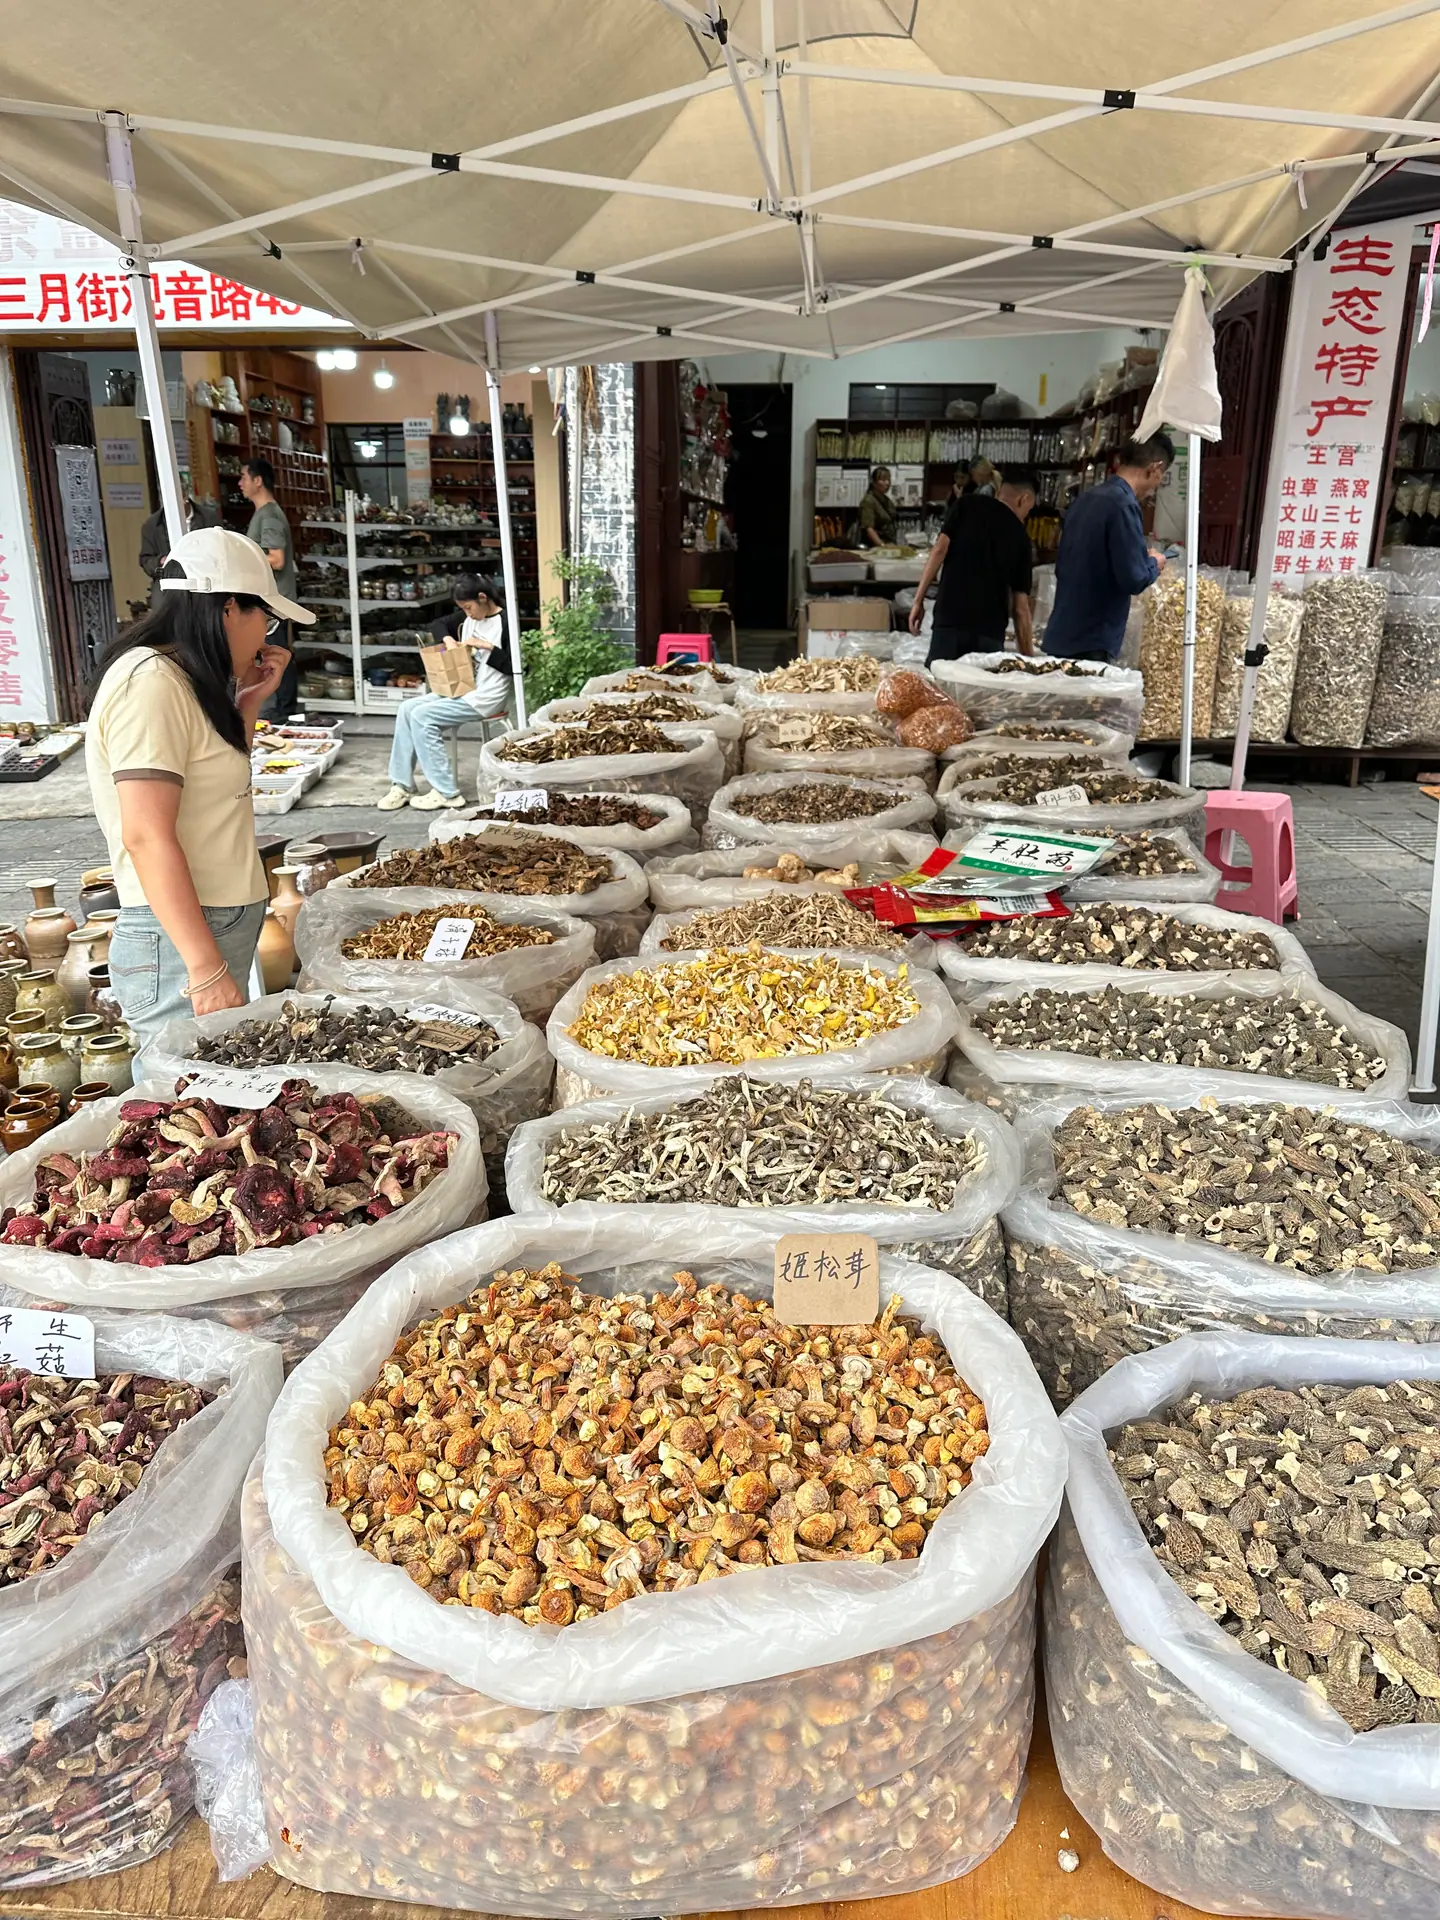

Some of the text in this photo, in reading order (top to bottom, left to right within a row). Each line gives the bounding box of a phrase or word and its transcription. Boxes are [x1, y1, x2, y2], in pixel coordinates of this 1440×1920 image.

[1306, 235, 1395, 437] 生态特产
[1281, 477, 1370, 499] 虫草 燕窝
[1279, 503, 1363, 524] 文山三七
[1276, 530, 1360, 550] 昭通天麻
[1273, 555, 1356, 575] 野生松茸
[981, 838, 1075, 869] 羊肚菌
[779, 1247, 872, 1290] 姬松茸
